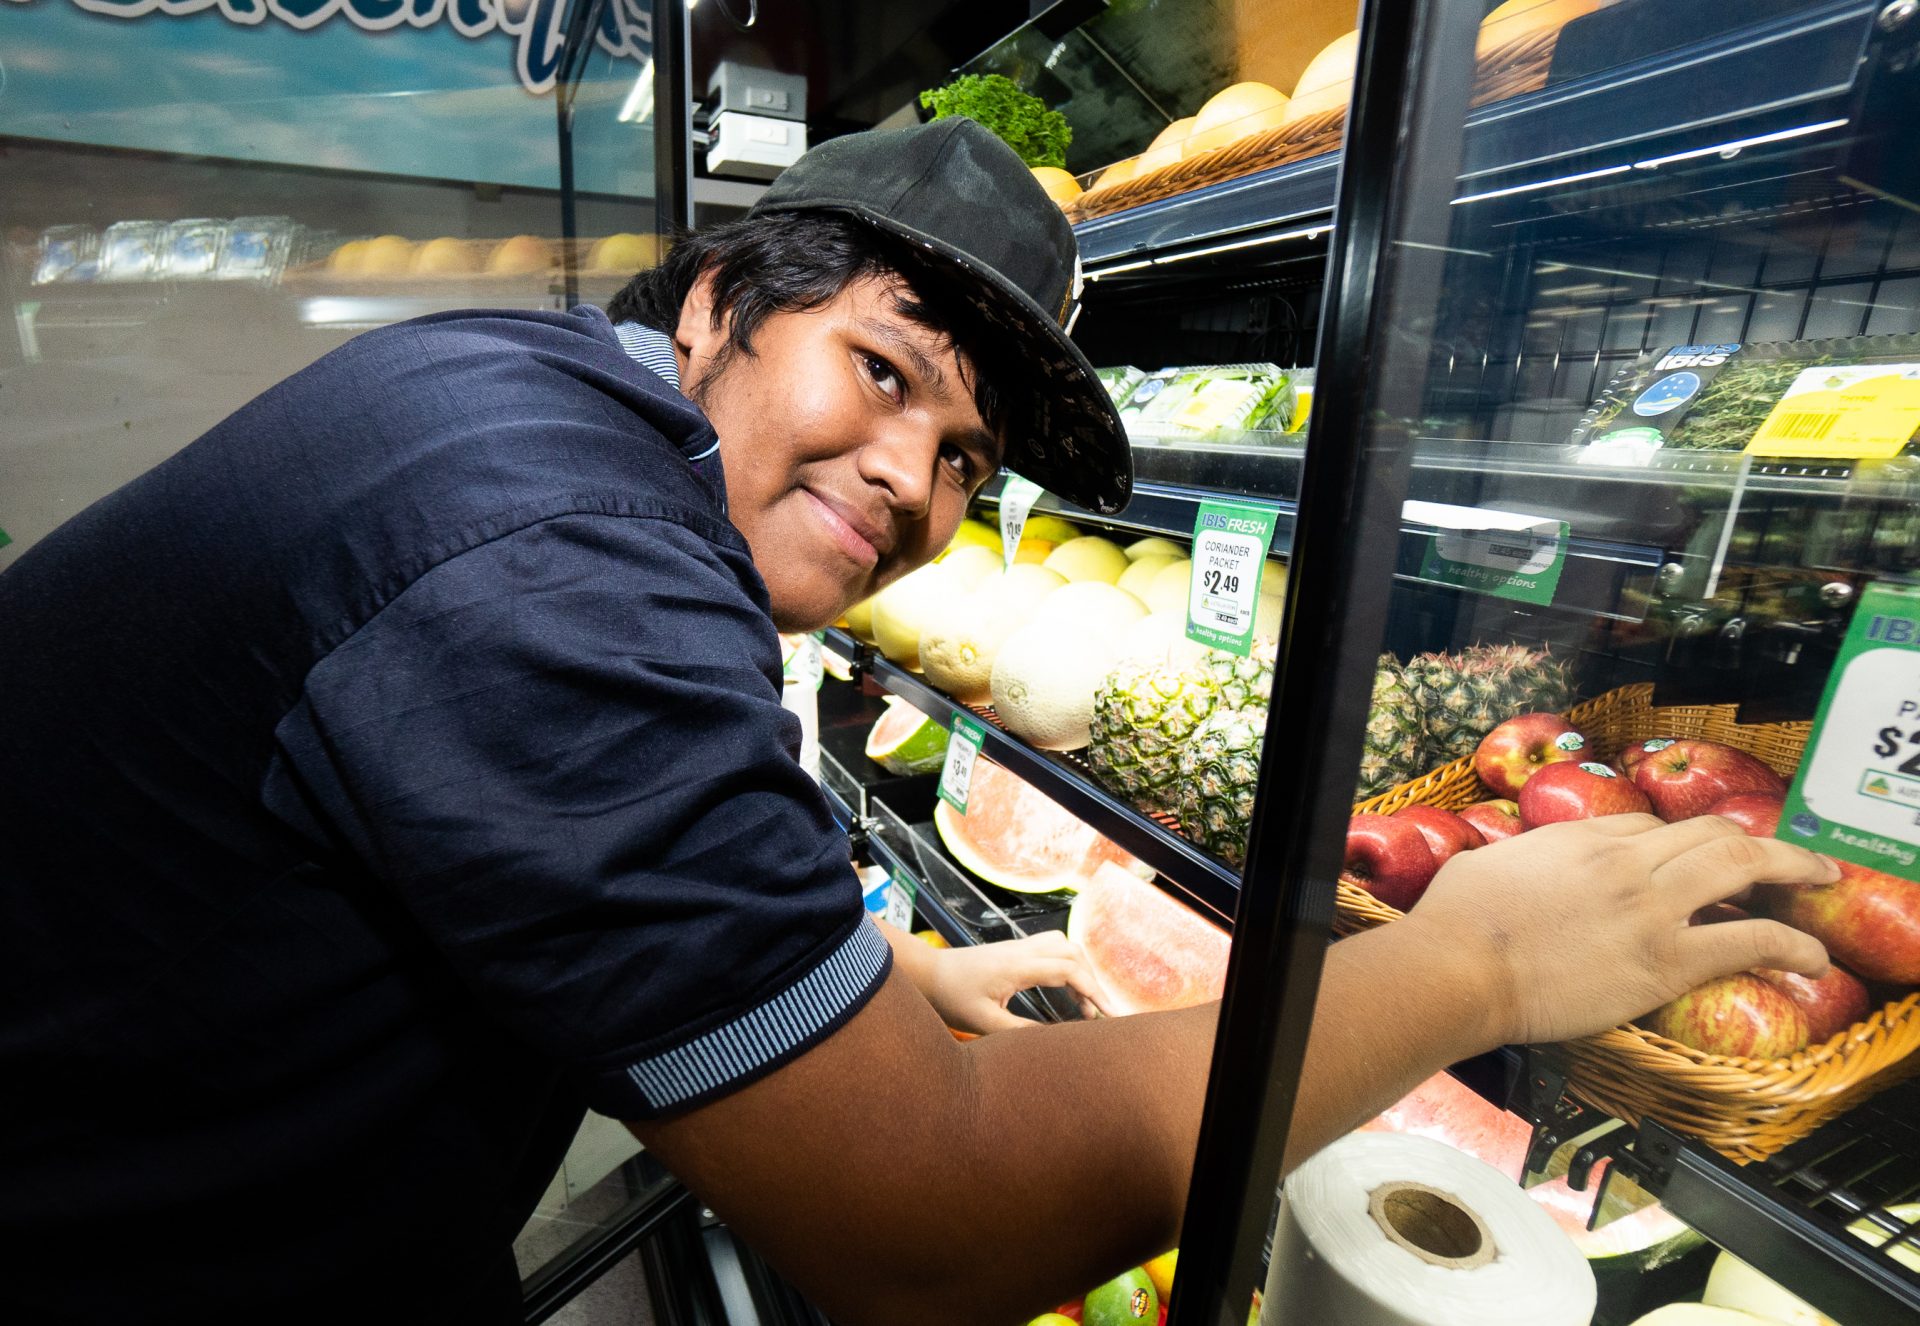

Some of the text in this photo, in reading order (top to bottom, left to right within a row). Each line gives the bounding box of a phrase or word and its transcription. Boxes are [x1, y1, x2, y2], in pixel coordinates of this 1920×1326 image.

[1202, 513, 1267, 535] IBIS FRESH
[1205, 541, 1250, 557] CORIANDER
[1209, 556, 1239, 570] PACKET
[1203, 570, 1239, 596] $2.49
[1448, 563, 1537, 589] healthy options
[1196, 626, 1242, 647] healthy options
[1868, 615, 1920, 644] IB
[1899, 700, 1920, 718] P
[1830, 827, 1917, 866] healthy
